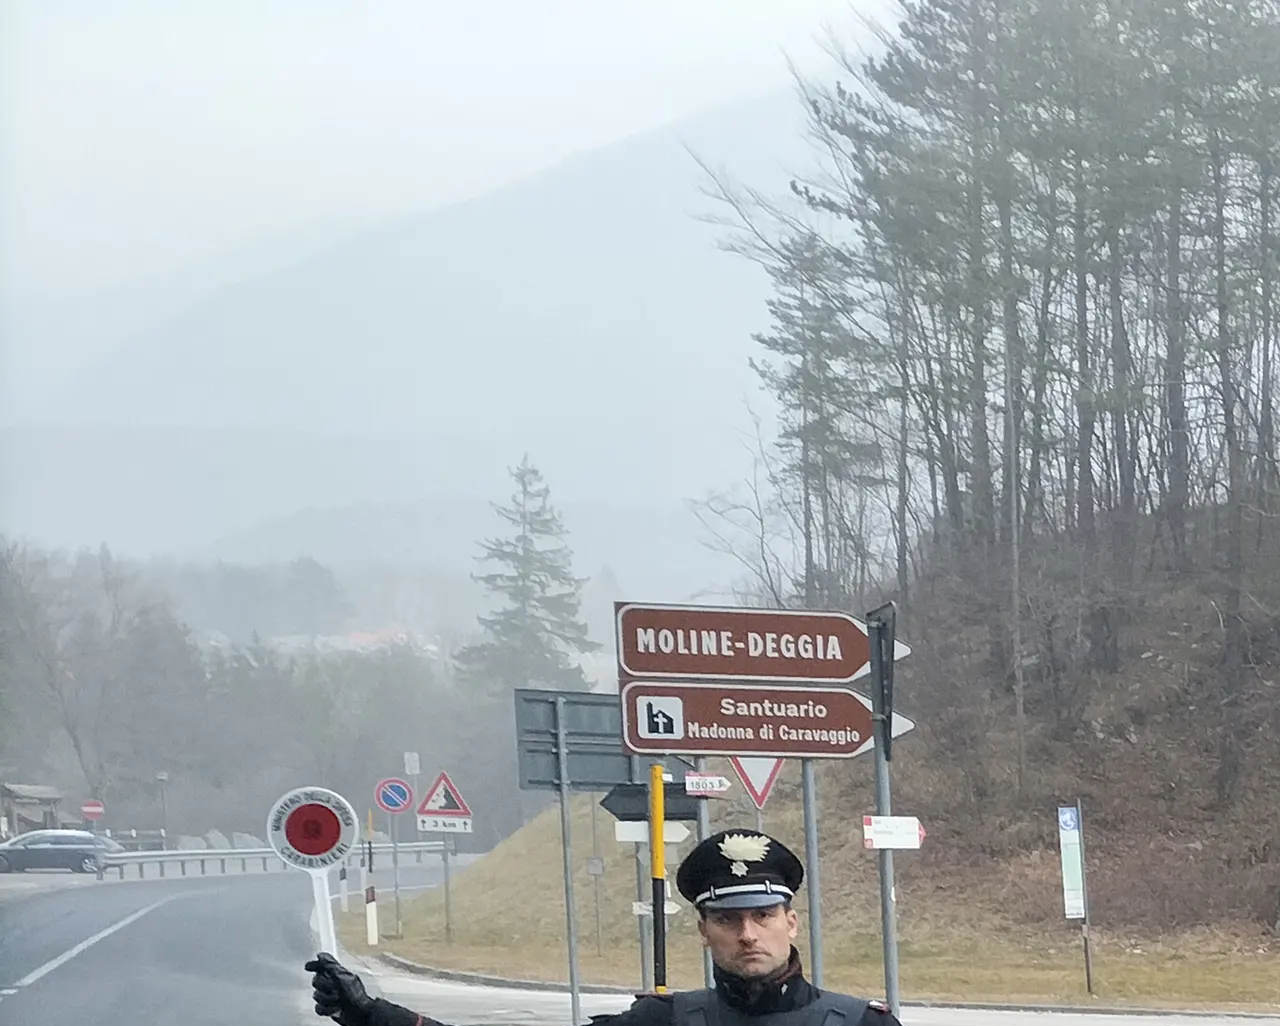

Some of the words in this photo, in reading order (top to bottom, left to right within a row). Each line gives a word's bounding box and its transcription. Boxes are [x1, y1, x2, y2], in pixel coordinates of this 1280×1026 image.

[636, 627, 843, 661] MOLINE-DEGGIA
[720, 697, 828, 718] Santuario
[687, 721, 754, 740] Madonna
[759, 724, 774, 741] di
[779, 725, 860, 746] Caravaggio
